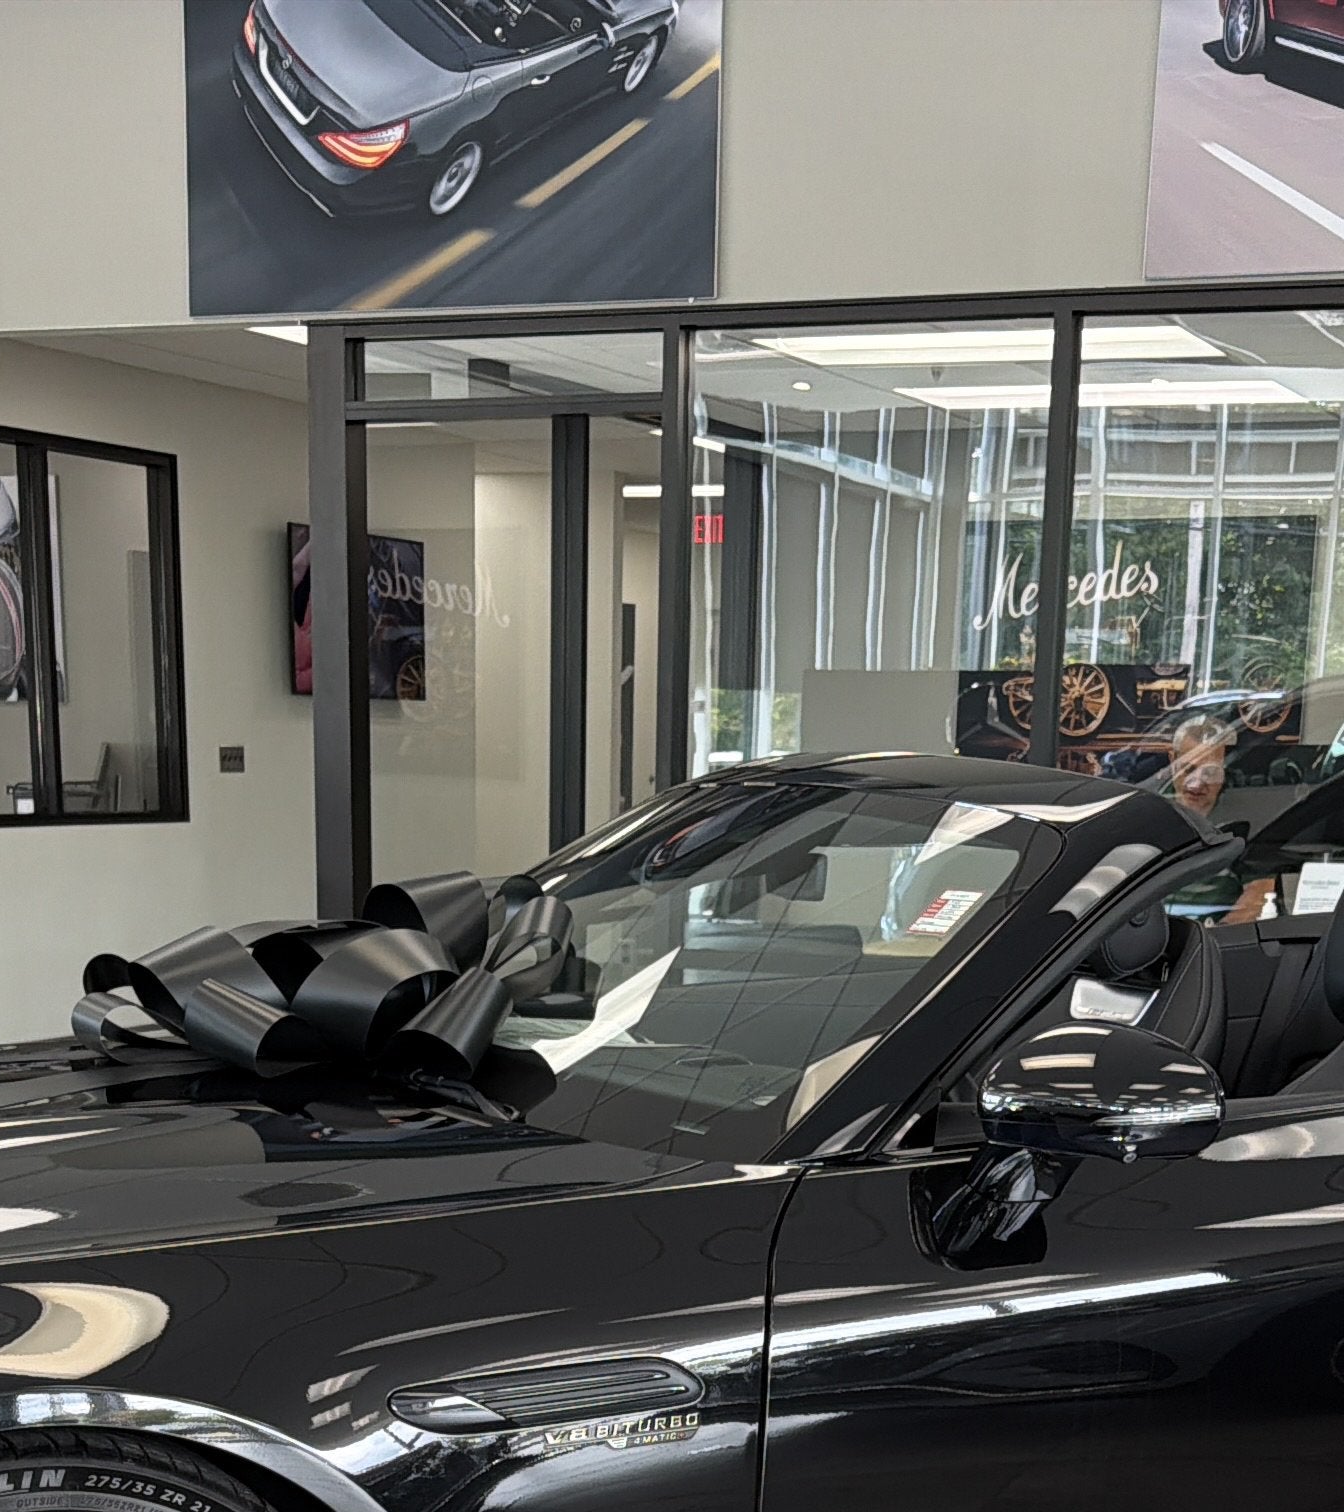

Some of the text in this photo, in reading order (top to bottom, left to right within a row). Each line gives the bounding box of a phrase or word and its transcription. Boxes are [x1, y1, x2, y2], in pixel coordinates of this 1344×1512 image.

[972, 539, 1159, 631] Mecedes
[544, 1412, 700, 1445] V8 BITURBO
[16, 1496, 63, 1508] OUTSIDE
[84, 1474, 156, 1496] 275/35
[159, 1488, 186, 1506] ZR
